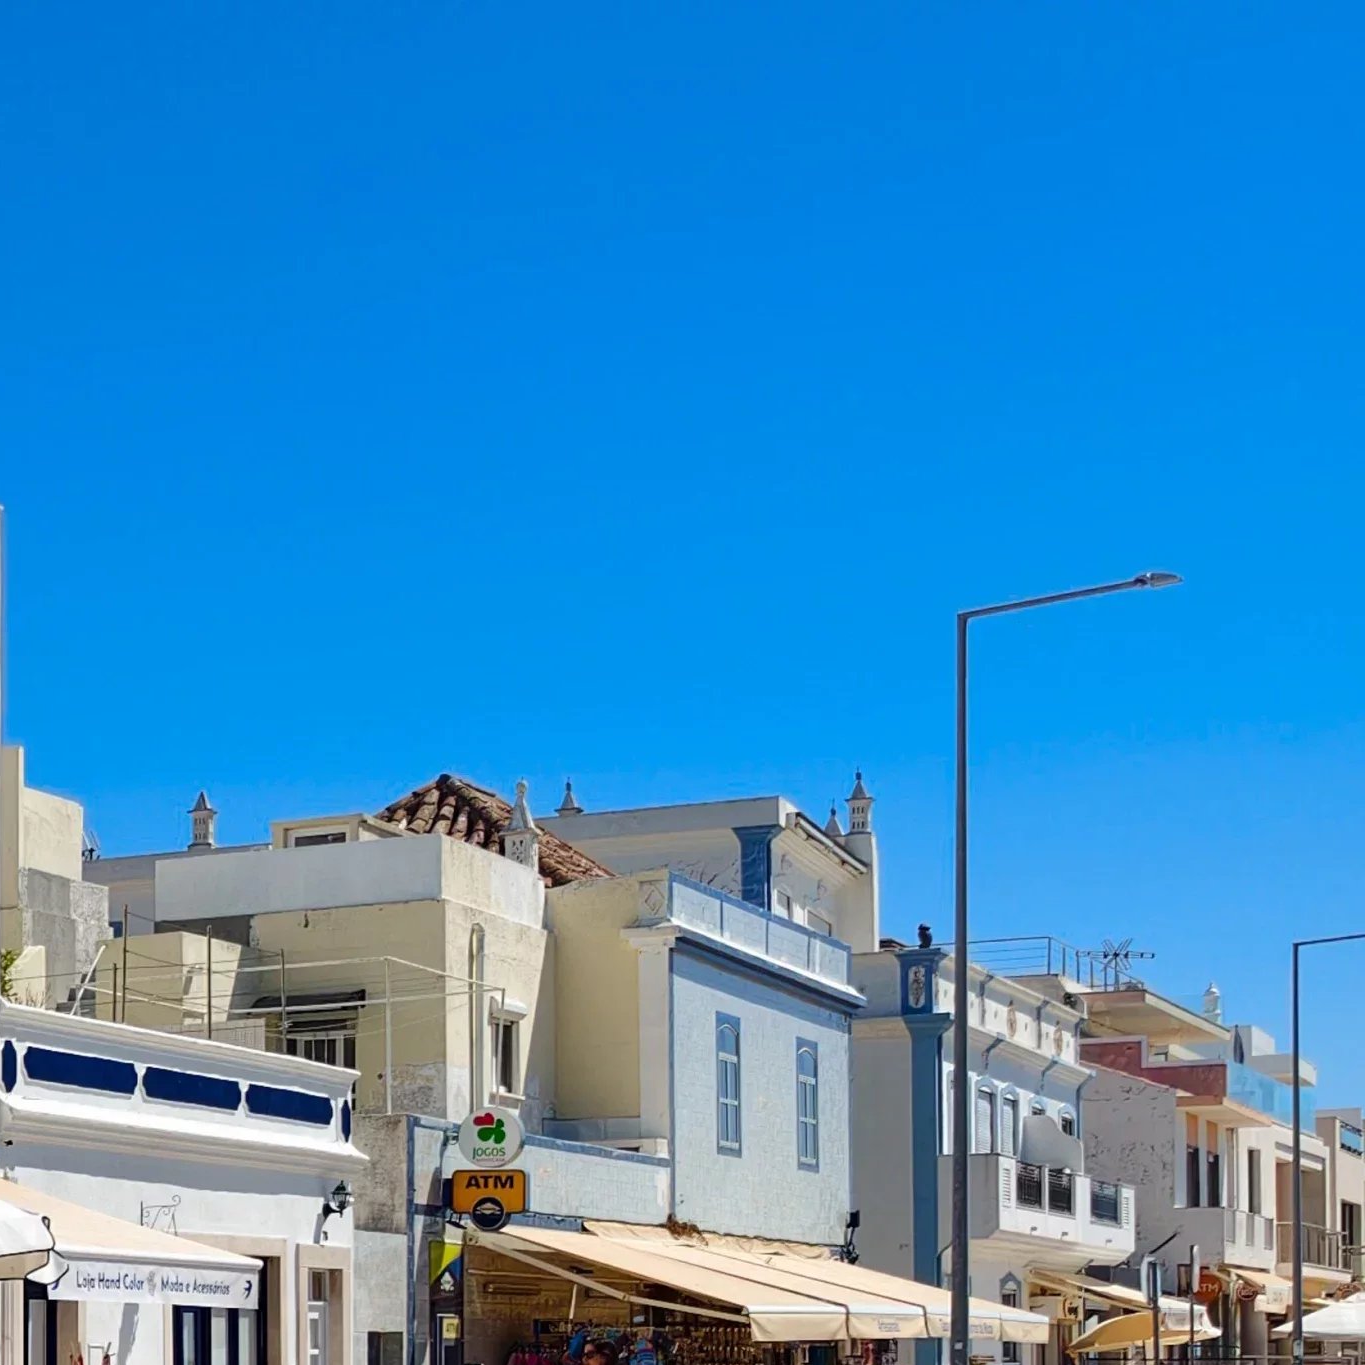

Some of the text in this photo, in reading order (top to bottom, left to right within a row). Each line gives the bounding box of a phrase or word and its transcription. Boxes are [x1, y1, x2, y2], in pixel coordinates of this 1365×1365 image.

[472, 1147, 506, 1160] JOGOS
[465, 1175, 514, 1189] ATM
[76, 1270, 96, 1292] Loja
[98, 1271, 120, 1290] Hand
[161, 1276, 184, 1293] Moda
[185, 1283, 191, 1293] e
[193, 1279, 230, 1296] Acessórios
